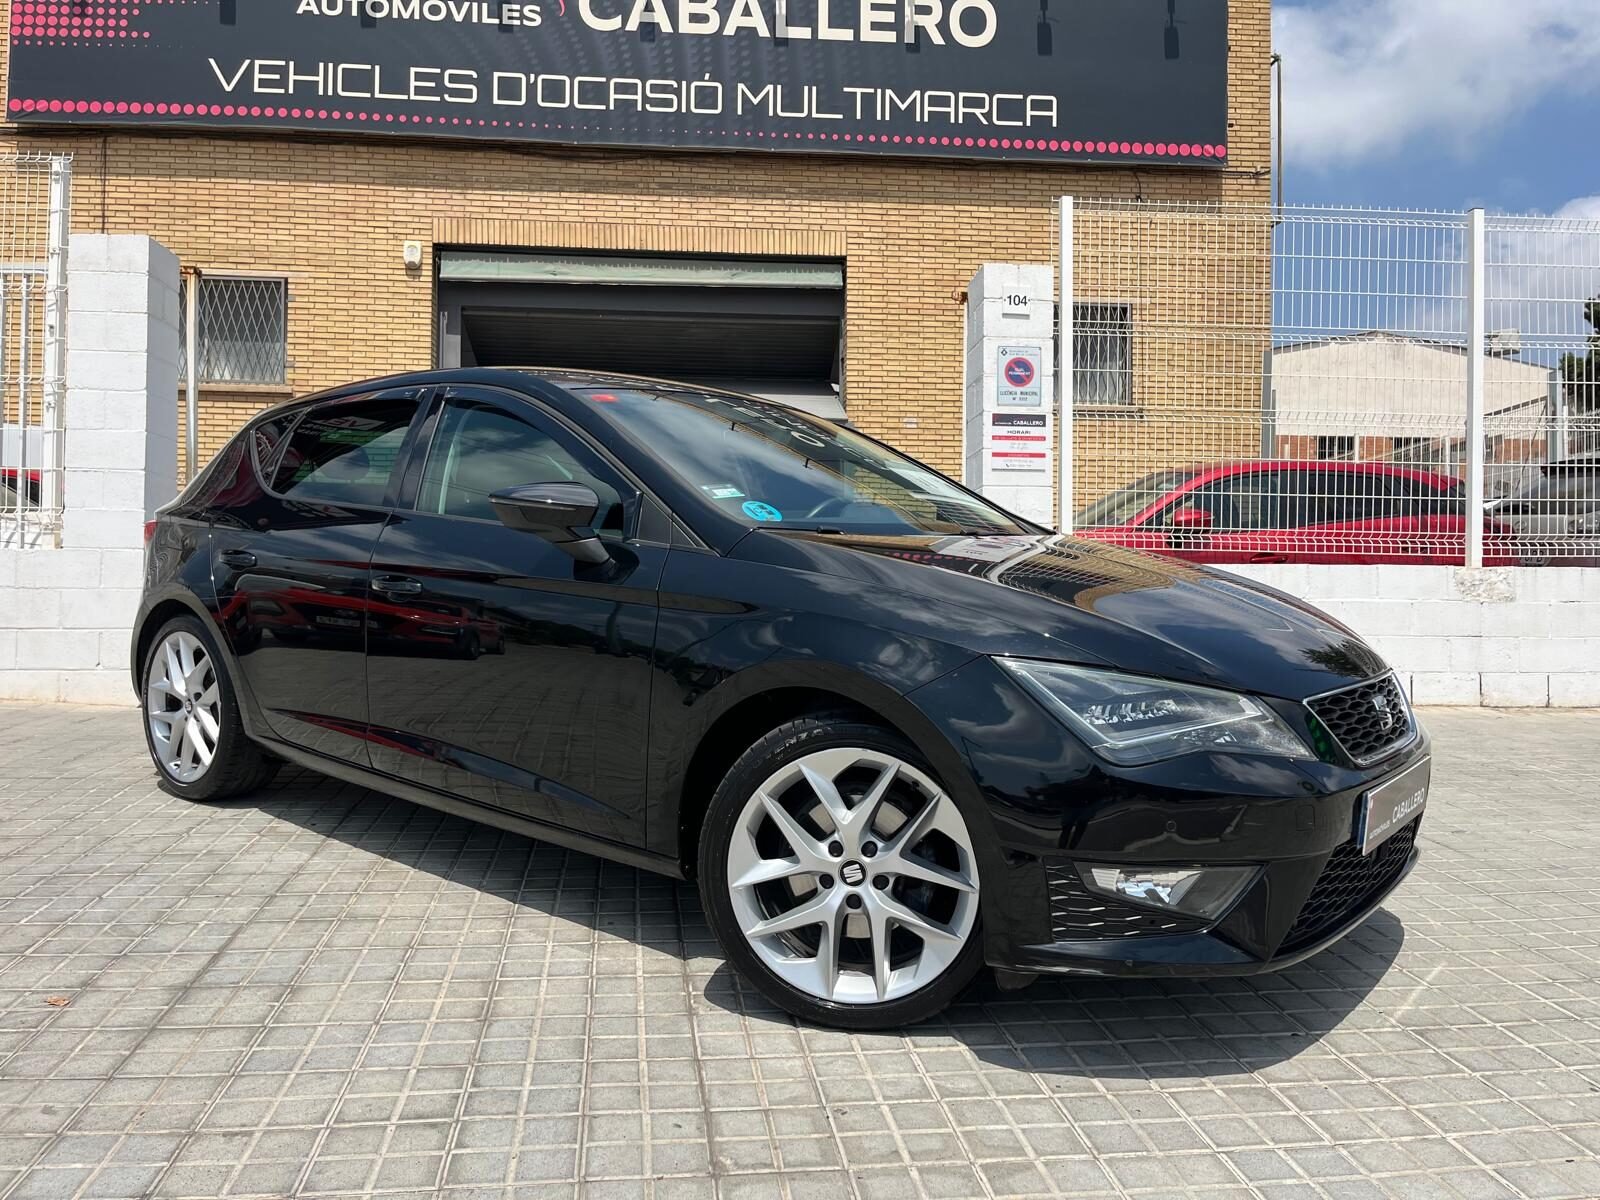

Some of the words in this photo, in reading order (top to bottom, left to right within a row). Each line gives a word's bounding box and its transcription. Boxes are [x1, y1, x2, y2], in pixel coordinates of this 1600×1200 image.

[296, 0, 542, 27] AUTOMOVILES
[577, 0, 998, 48] CABALLERO
[208, 58, 478, 104] VEHICLES
[492, 71, 723, 115] D'OCASIÓ
[736, 82, 1058, 127] MULTIMARCA
[1006, 294, 1028, 307] 104
[1392, 787, 1425, 824] CABALLERO
